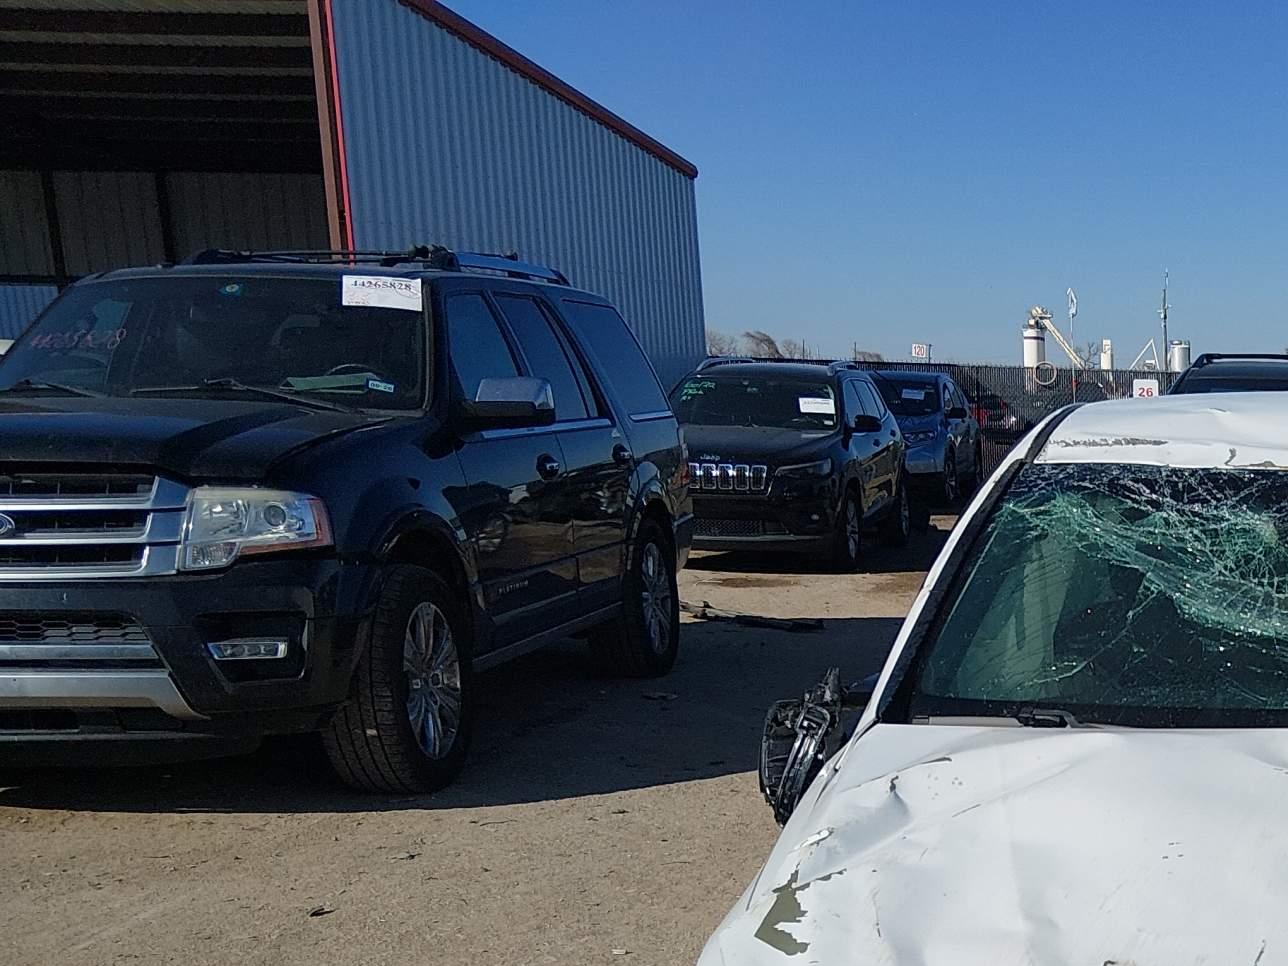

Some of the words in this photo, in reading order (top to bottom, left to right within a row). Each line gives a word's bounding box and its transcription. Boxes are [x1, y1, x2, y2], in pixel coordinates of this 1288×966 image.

[351, 279, 412, 292] 44265828
[913, 345, 925, 357] 120
[1138, 387, 1154, 398] 26
[699, 453, 721, 462] Jeep
